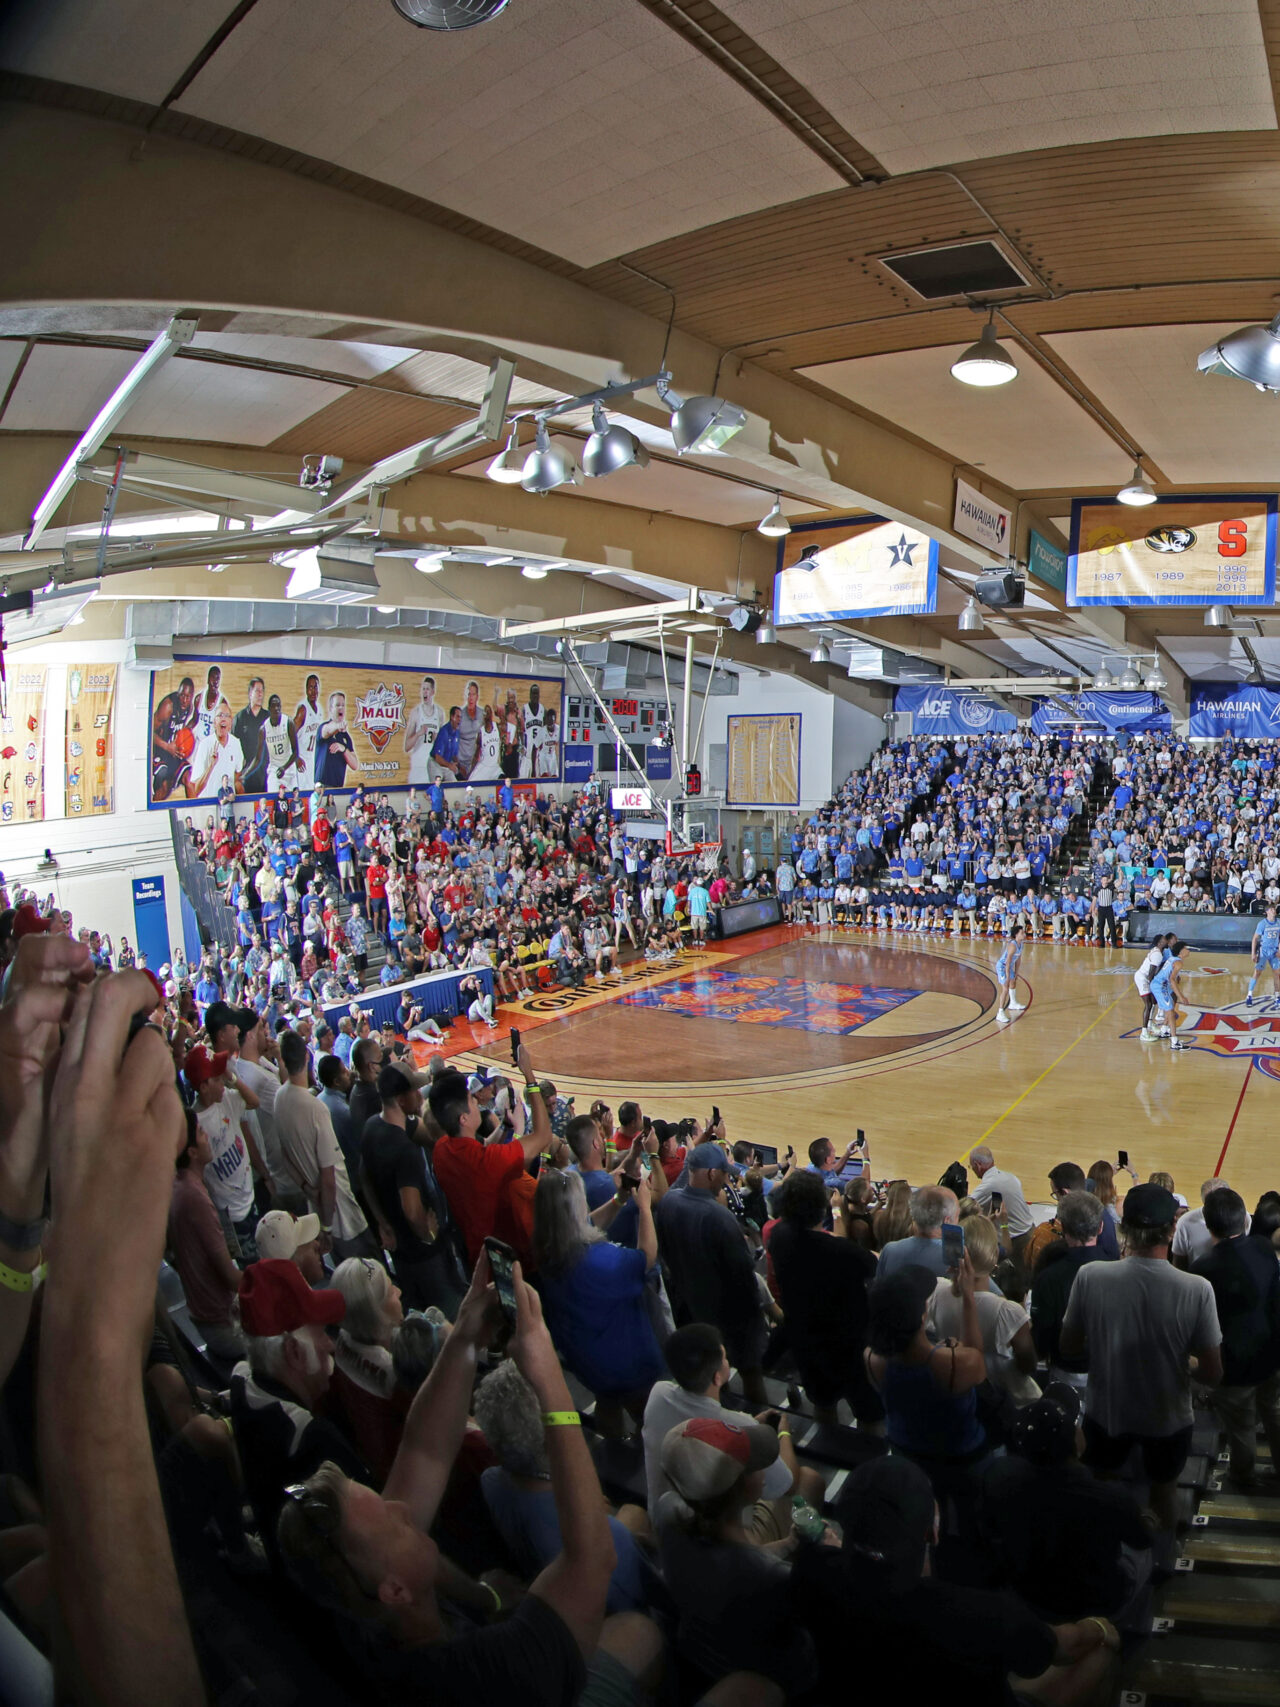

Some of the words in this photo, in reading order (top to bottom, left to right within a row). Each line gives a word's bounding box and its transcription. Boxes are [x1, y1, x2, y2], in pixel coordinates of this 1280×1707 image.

[961, 499, 997, 529] HAWAIIAN
[1218, 520, 1247, 557] S
[1217, 565, 1247, 574] 1990
[1094, 572, 1122, 581] 1987
[1155, 572, 1185, 580] 1989
[1217, 574, 1247, 583] 1998
[1215, 583, 1247, 592] 2013
[20, 675, 42, 685] 2022
[88, 675, 110, 685] 2023
[612, 699, 638, 716] 20:00
[918, 699, 952, 714] ACE
[1197, 701, 1261, 712] HAWAIIAN
[361, 706, 399, 720] MAUI
[203, 724, 211, 736] 3
[423, 731, 434, 744] 13
[273, 743, 285, 755] 12
[489, 745, 496, 757] 0
[688, 773, 700, 792] 30
[621, 793, 643, 806] ACE
[141, 882, 155, 890] Team
[1267, 931, 1278, 939] 55
